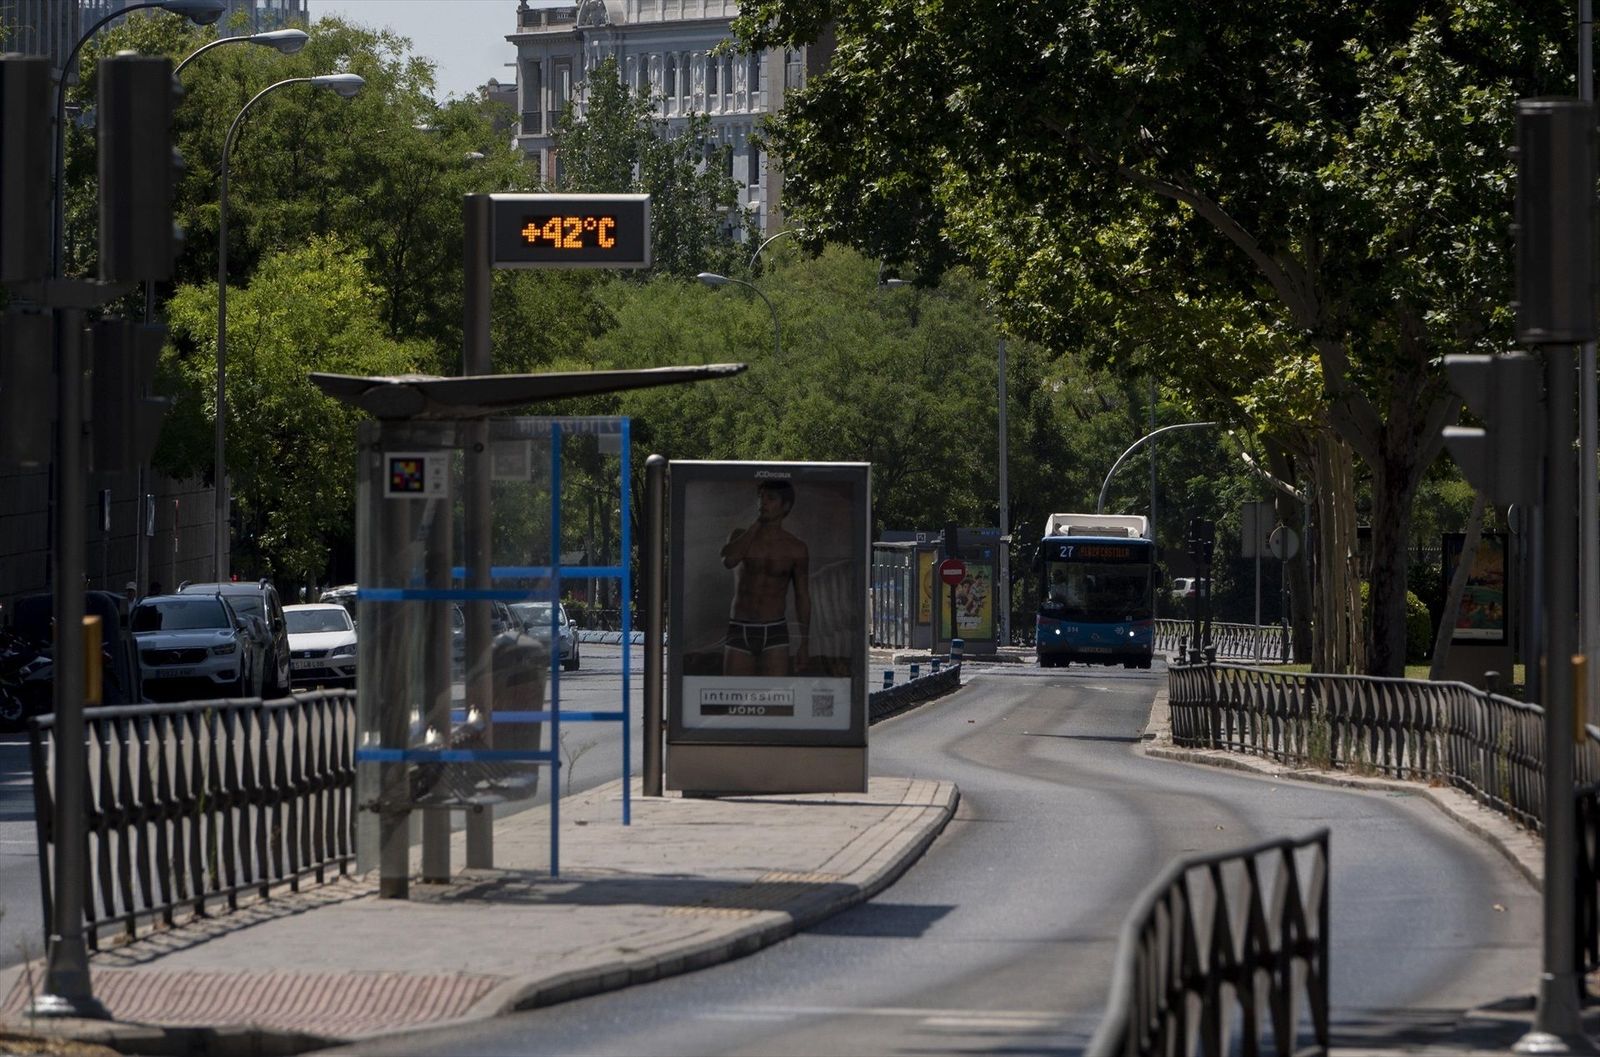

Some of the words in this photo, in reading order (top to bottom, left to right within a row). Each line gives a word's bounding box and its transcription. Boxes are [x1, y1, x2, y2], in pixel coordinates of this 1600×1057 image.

[522, 217, 614, 248] +42°C
[753, 470, 792, 478] JCDecaux
[1060, 546, 1074, 558] 27
[704, 690, 791, 701] intimissimi
[728, 706, 766, 715] UOMO
